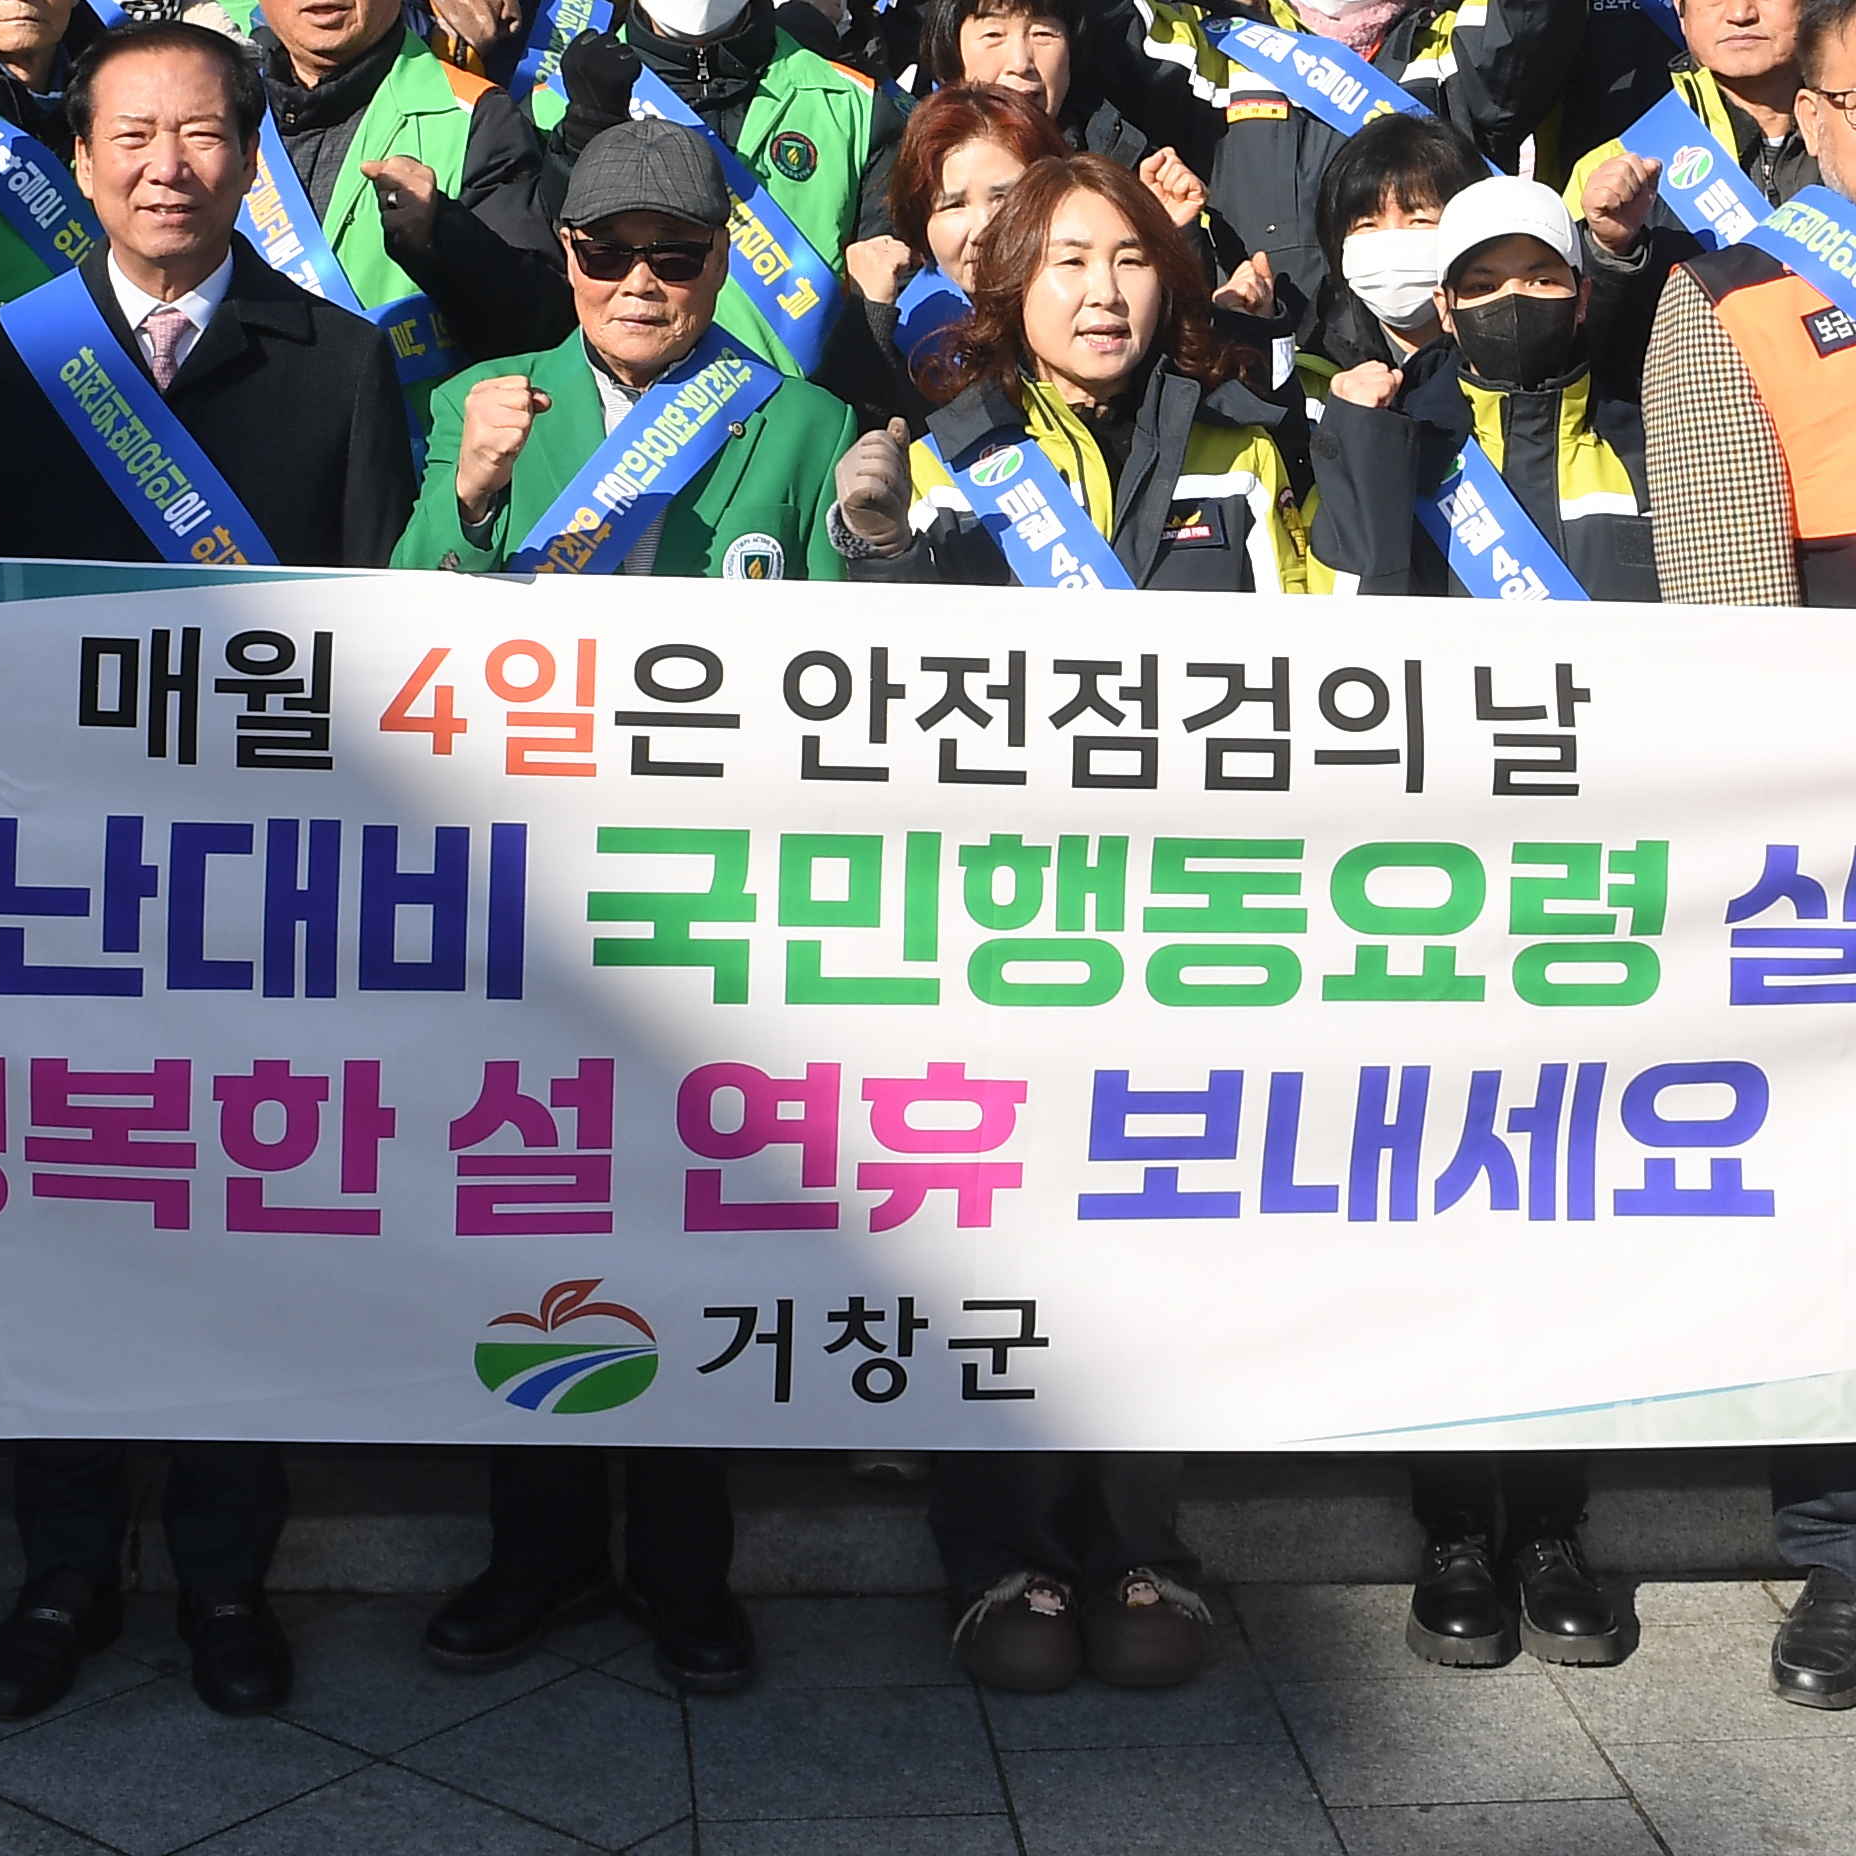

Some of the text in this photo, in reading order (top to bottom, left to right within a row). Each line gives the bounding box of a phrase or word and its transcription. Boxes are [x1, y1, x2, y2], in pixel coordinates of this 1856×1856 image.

[1236, 25, 1298, 63] 매월
[1292, 52, 1368, 114] 4일은
[61, 347, 210, 535] 안전위험요인은
[595, 348, 752, 514] 안전위험요인은
[996, 478, 1066, 552] 매월
[1438, 481, 1505, 556] 매월
[79, 627, 1590, 799] 매월 4일은 안전점검의 날
[585, 826, 1671, 1008] 국민행동요령
[449, 1057, 615, 1236] 설
[676, 1060, 1029, 1235] 연휴
[1076, 1060, 1776, 1222] 보내세요
[696, 1296, 1051, 1405] 거창군
